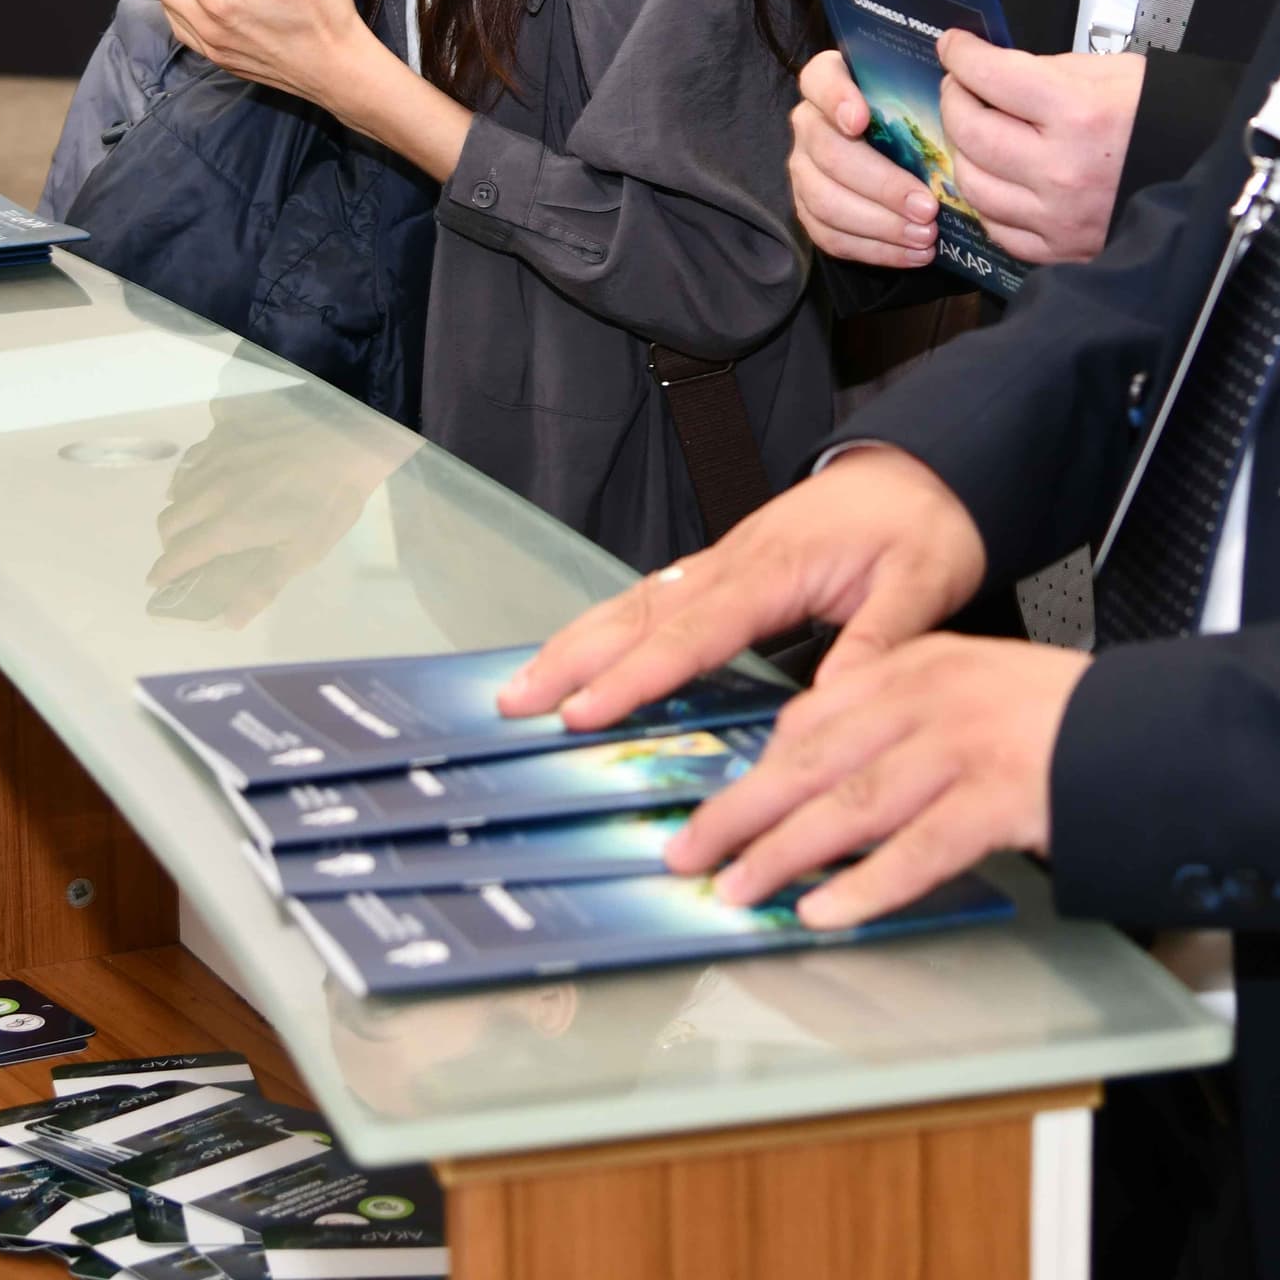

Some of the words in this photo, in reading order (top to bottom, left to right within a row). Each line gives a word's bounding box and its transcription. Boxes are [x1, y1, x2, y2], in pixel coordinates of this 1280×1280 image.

[939, 238, 993, 277] AKAP
[140, 1057, 199, 1069] AKAP
[361, 1229, 424, 1242] AKAP
